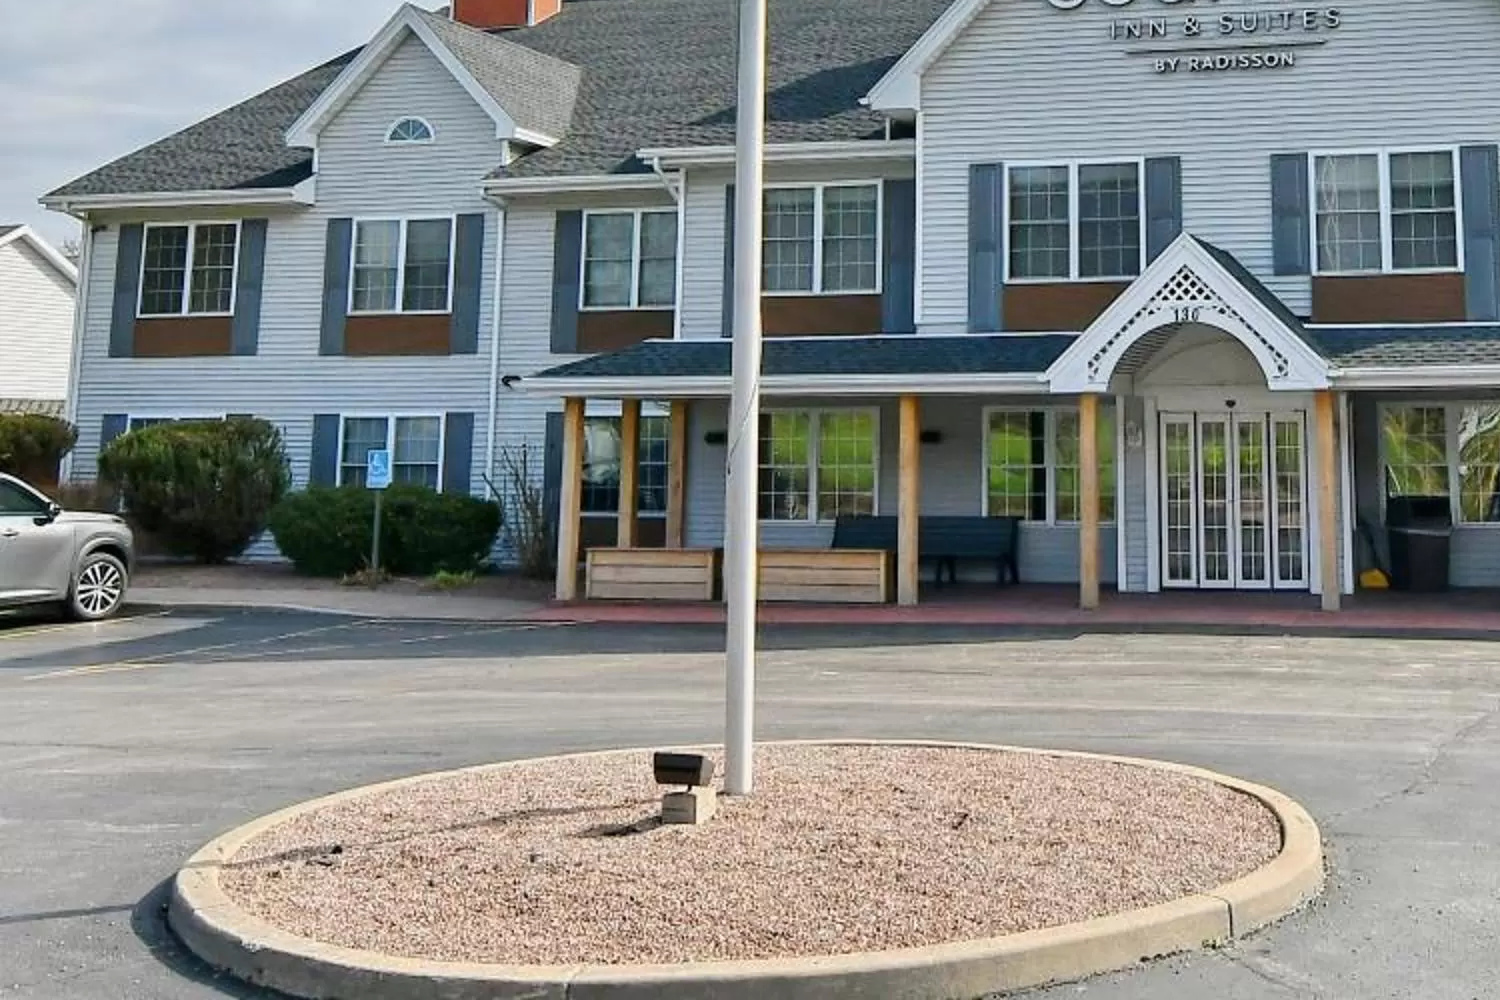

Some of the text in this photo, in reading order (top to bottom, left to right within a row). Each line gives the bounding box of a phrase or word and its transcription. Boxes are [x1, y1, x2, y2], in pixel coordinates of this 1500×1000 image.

[1110, 8, 1341, 40] INN & SUITES
[1154, 51, 1295, 73] BY RADISSON
